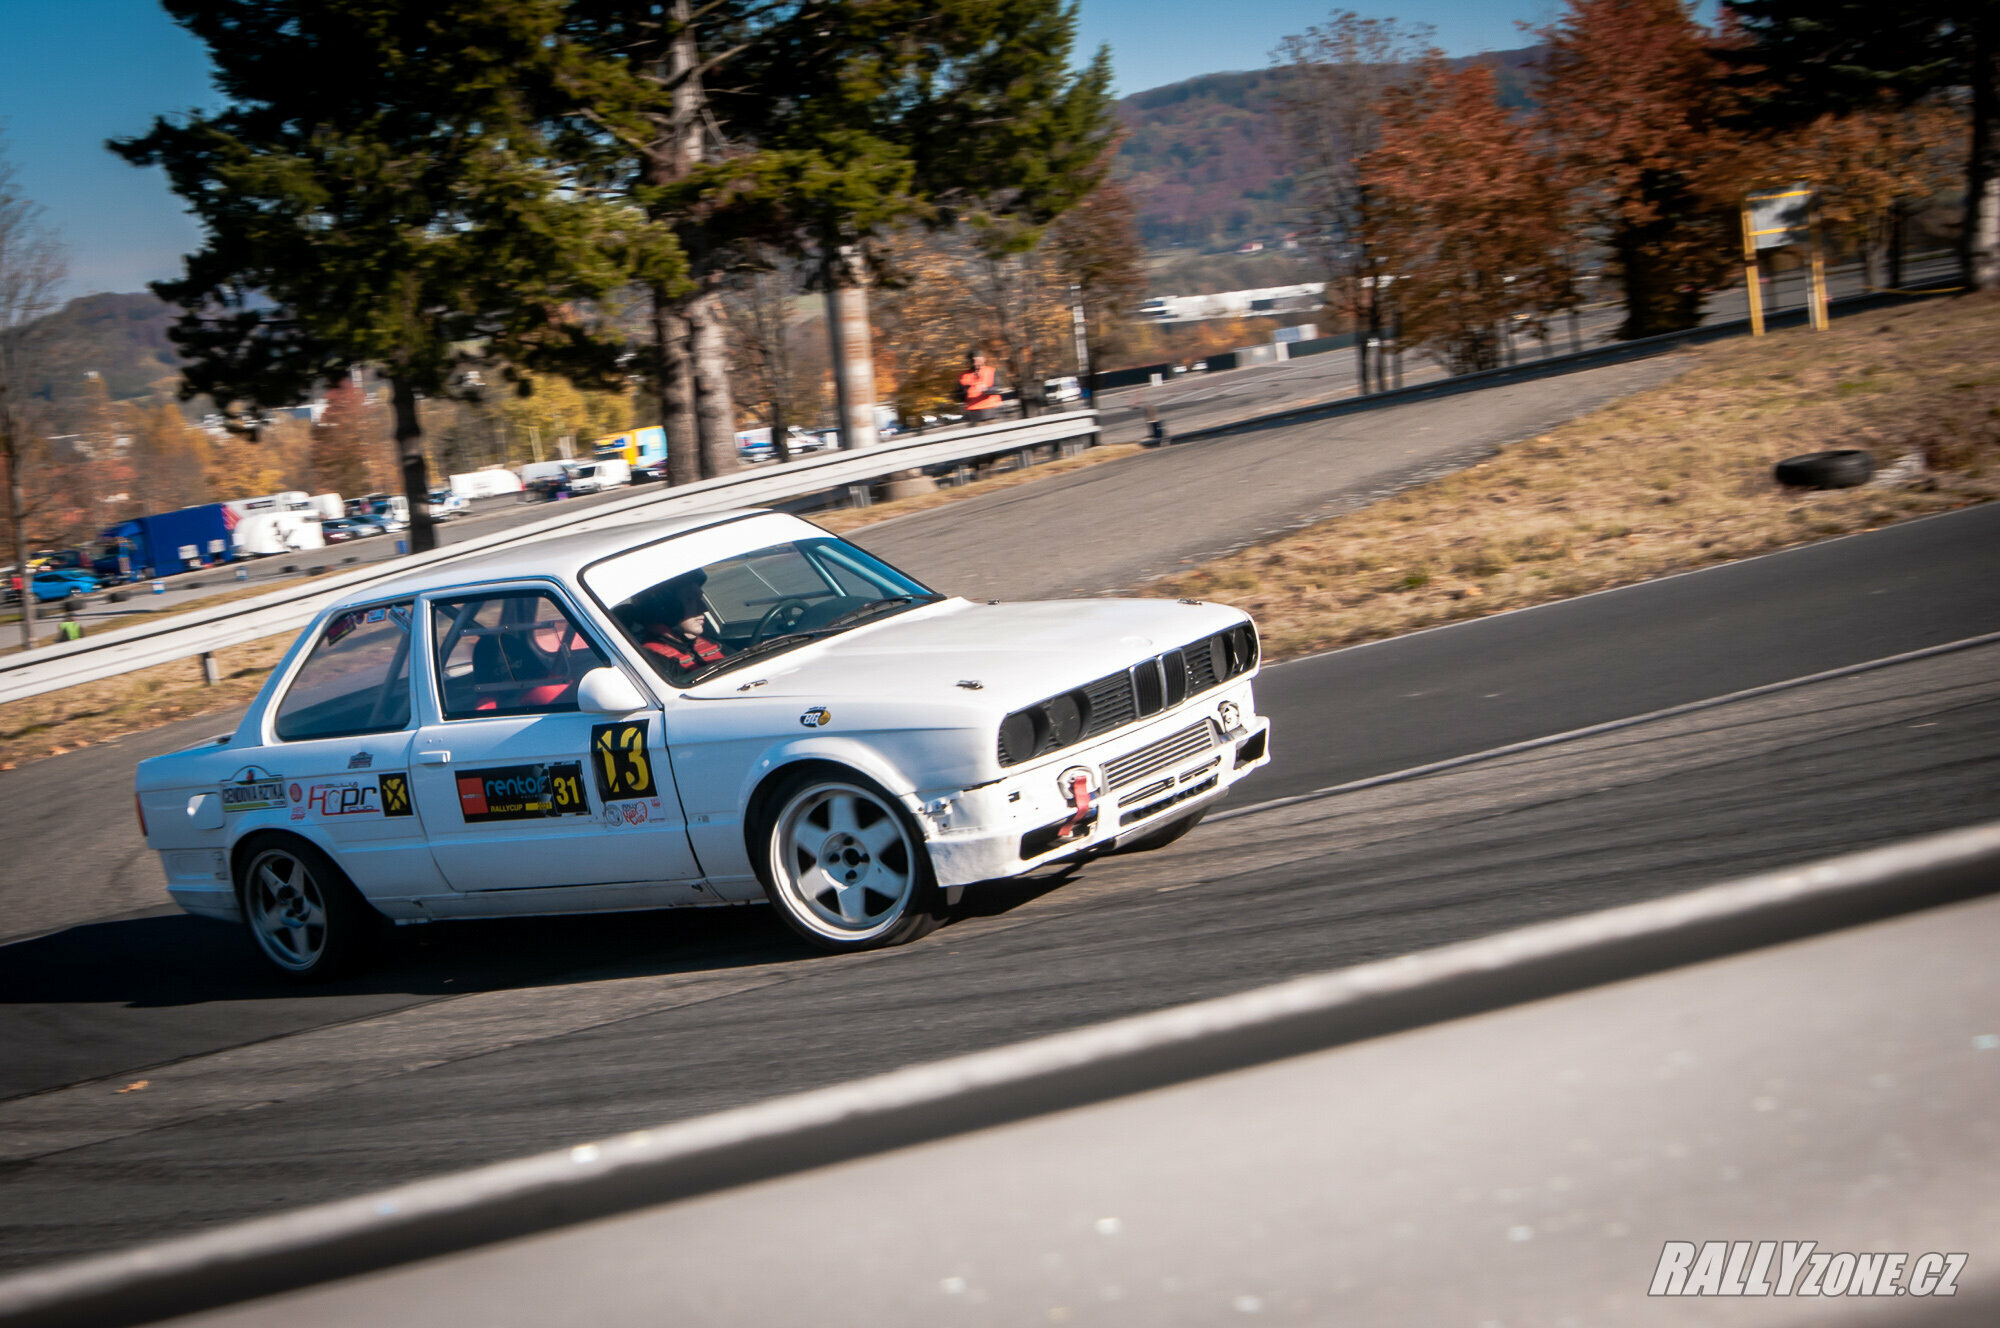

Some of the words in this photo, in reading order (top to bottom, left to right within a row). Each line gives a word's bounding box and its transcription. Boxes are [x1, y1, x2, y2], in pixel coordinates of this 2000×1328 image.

[597, 727, 649, 792] 13
[553, 776, 580, 805] 31
[490, 804, 523, 813] RALLYCUP
